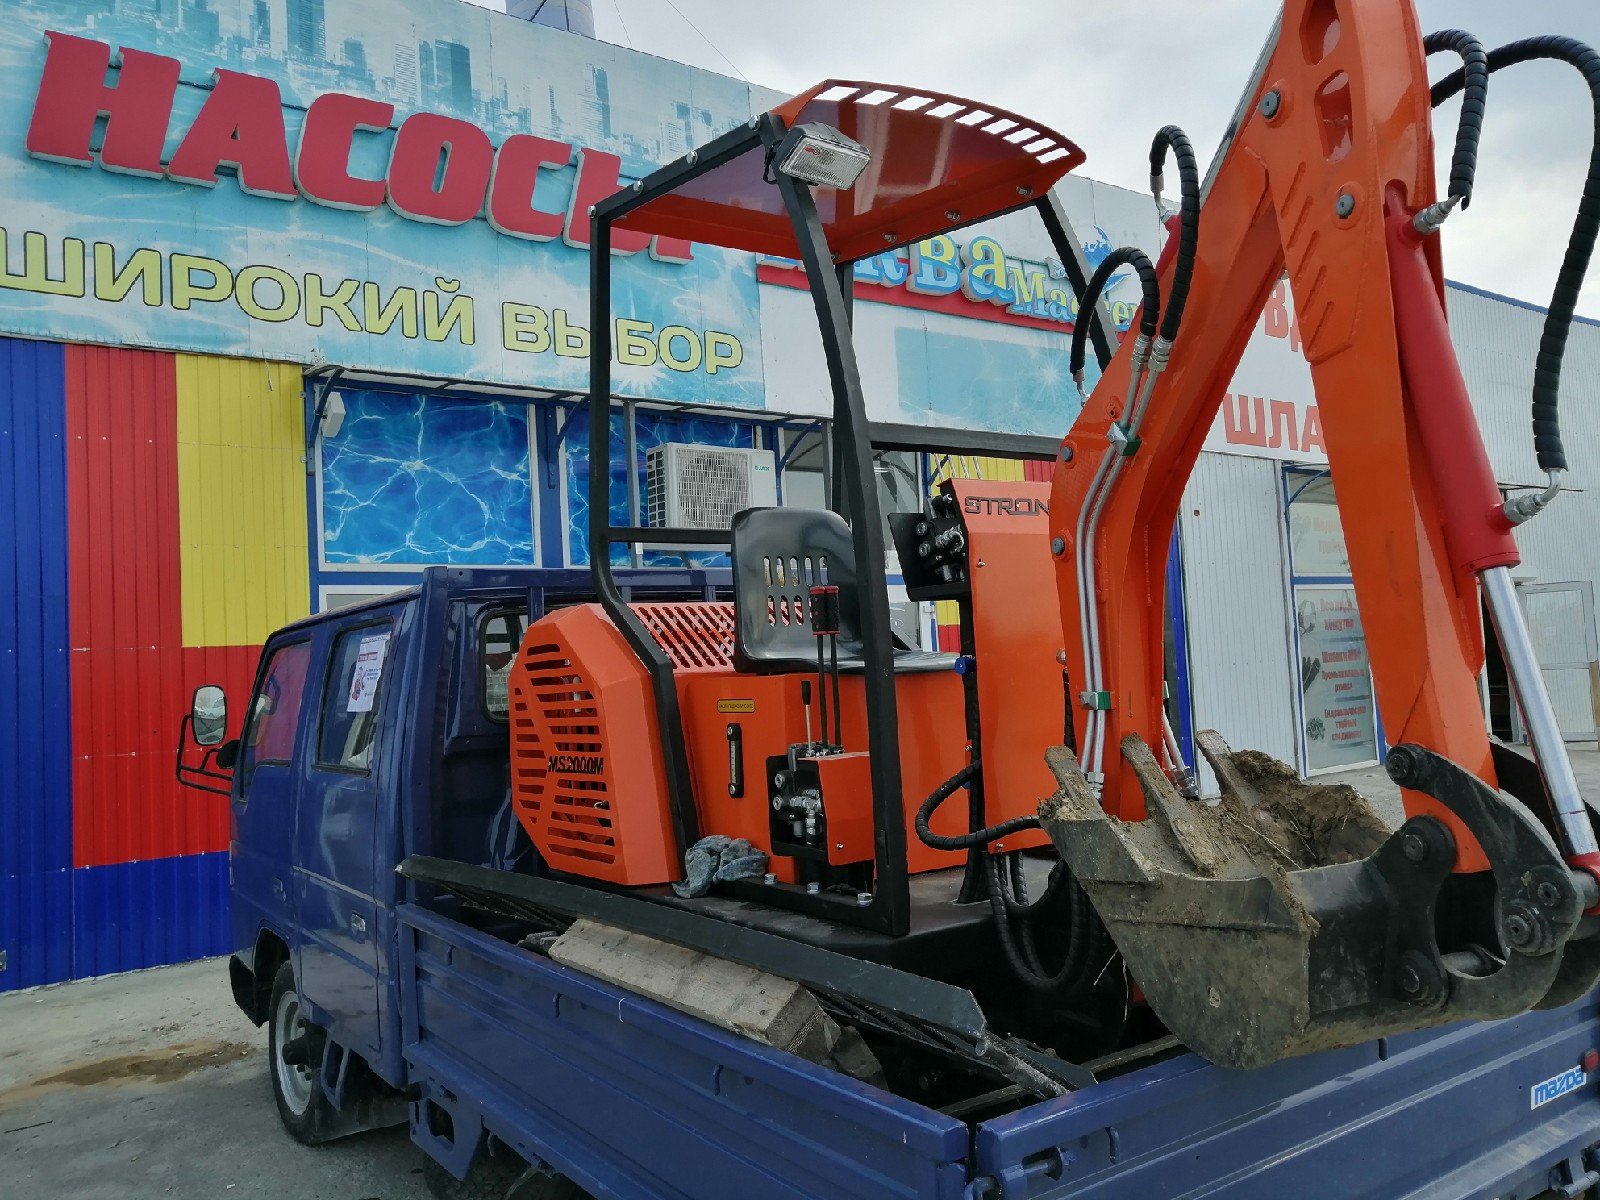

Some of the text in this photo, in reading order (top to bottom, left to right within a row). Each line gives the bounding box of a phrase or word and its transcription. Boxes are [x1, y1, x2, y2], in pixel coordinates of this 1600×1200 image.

[0, 226, 476, 346] ШИРОКИЙ
[1223, 393, 1328, 454] ШЛА
[548, 756, 604, 775] MS2000M
[1534, 1068, 1584, 1105] mazda
